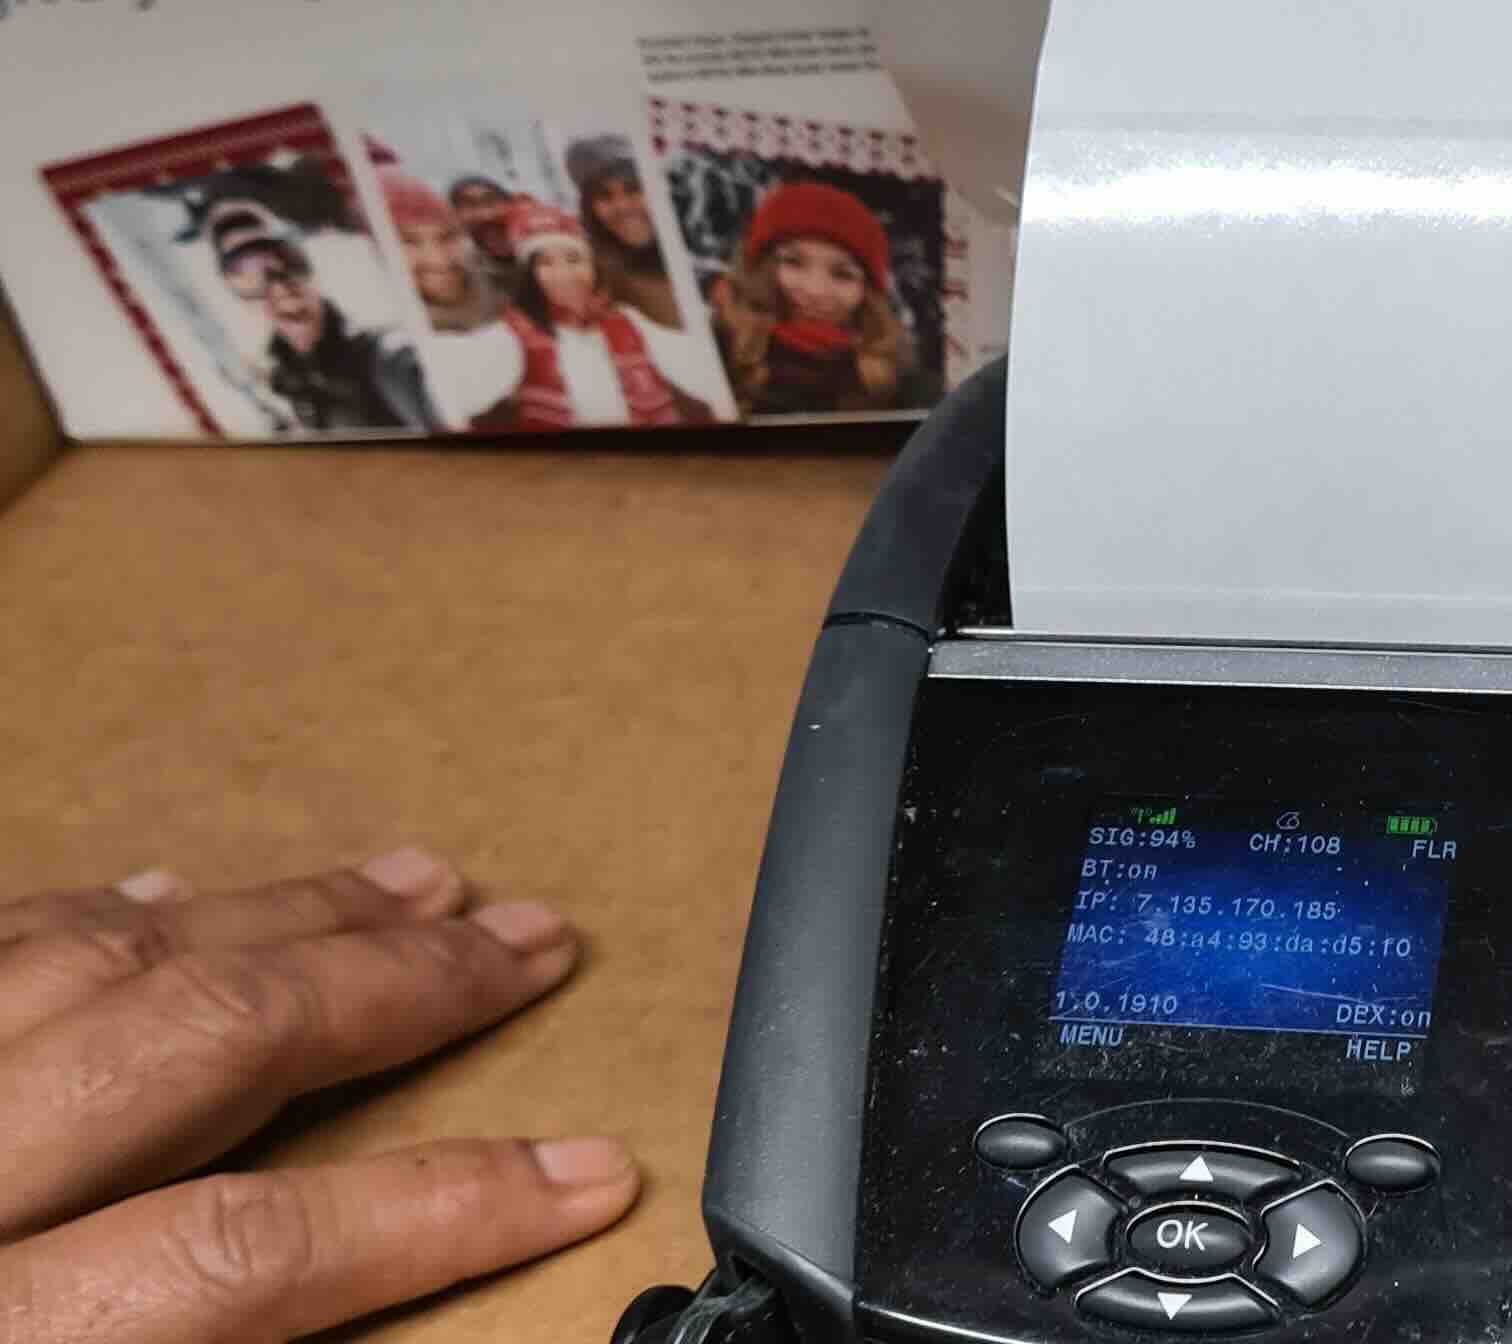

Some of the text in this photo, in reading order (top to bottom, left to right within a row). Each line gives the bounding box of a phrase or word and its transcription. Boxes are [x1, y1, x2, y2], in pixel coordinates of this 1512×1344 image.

[1088, 827, 1457, 861] SIG:94% CH:108 FLR
[1080, 858, 1159, 881] BT:on
[1073, 890, 1339, 921] IP: 7.135.170.185
[1066, 922, 1412, 958] MAC: 48:a4:93:da:d5:f0
[1335, 1003, 1432, 1028] DEX:on
[1059, 1023, 1124, 1047] MENU
[1345, 1038, 1412, 1062] HELP
[1155, 1218, 1210, 1252] OK
